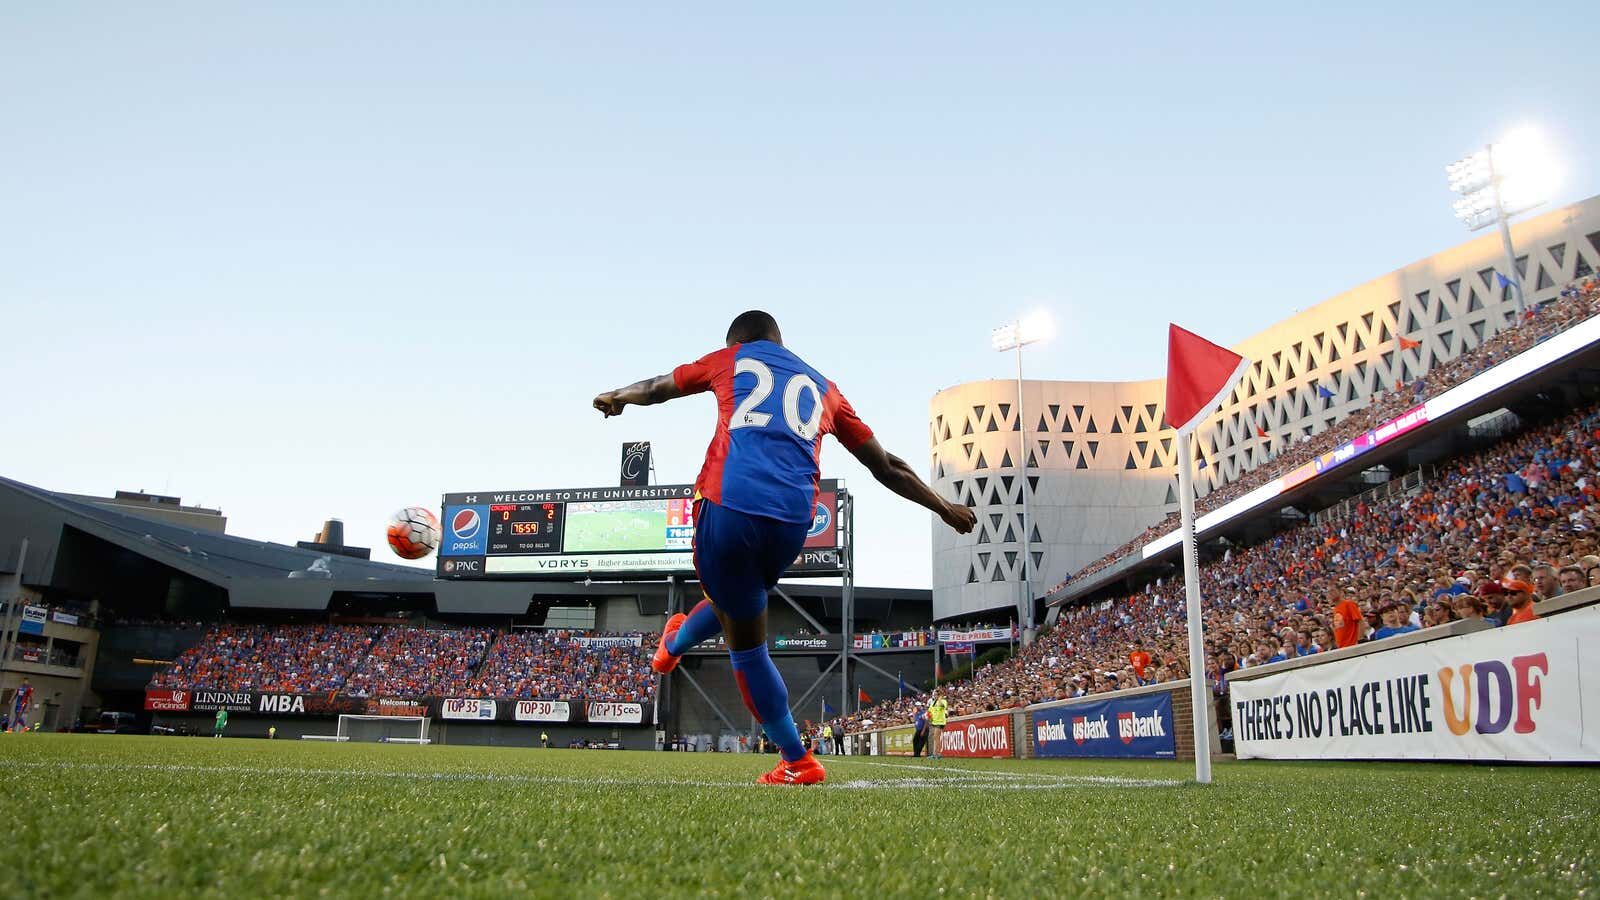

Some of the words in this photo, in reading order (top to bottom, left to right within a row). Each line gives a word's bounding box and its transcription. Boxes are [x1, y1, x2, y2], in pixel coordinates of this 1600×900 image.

[728, 357, 824, 441] 20
[494, 493, 551, 502] WELCOME
[556, 492, 571, 500] TO
[575, 491, 598, 499] THE
[603, 489, 677, 498] UNIVERSITY
[503, 511, 510, 520] 0
[547, 510, 554, 519] 2
[513, 523, 537, 533] 76:59
[452, 541, 477, 551] pepsi
[597, 559, 621, 568] Higher
[622, 558, 656, 567] standards
[657, 558, 676, 566] make
[678, 557, 694, 566] bett
[804, 553, 830, 564] PNC
[456, 561, 479, 570] PNC
[538, 560, 589, 569] VORYS
[778, 638, 827, 647] enterprise
[195, 692, 251, 704] LINDNER
[1236, 694, 1294, 741] THERE'S
[1296, 691, 1323, 739] NO
[1326, 682, 1384, 737] PLACE
[1386, 673, 1433, 735] LIKE
[1437, 652, 1549, 736] UDF
[152, 701, 187, 709] Cincinnati
[259, 695, 305, 712] MBA
[446, 700, 464, 712] TOP
[466, 701, 478, 713] 35
[520, 702, 537, 714] TOP
[539, 703, 551, 715] 30
[612, 704, 623, 716] 15
[942, 730, 966, 751] TOYOTA
[977, 725, 1008, 749] TOYOTA
